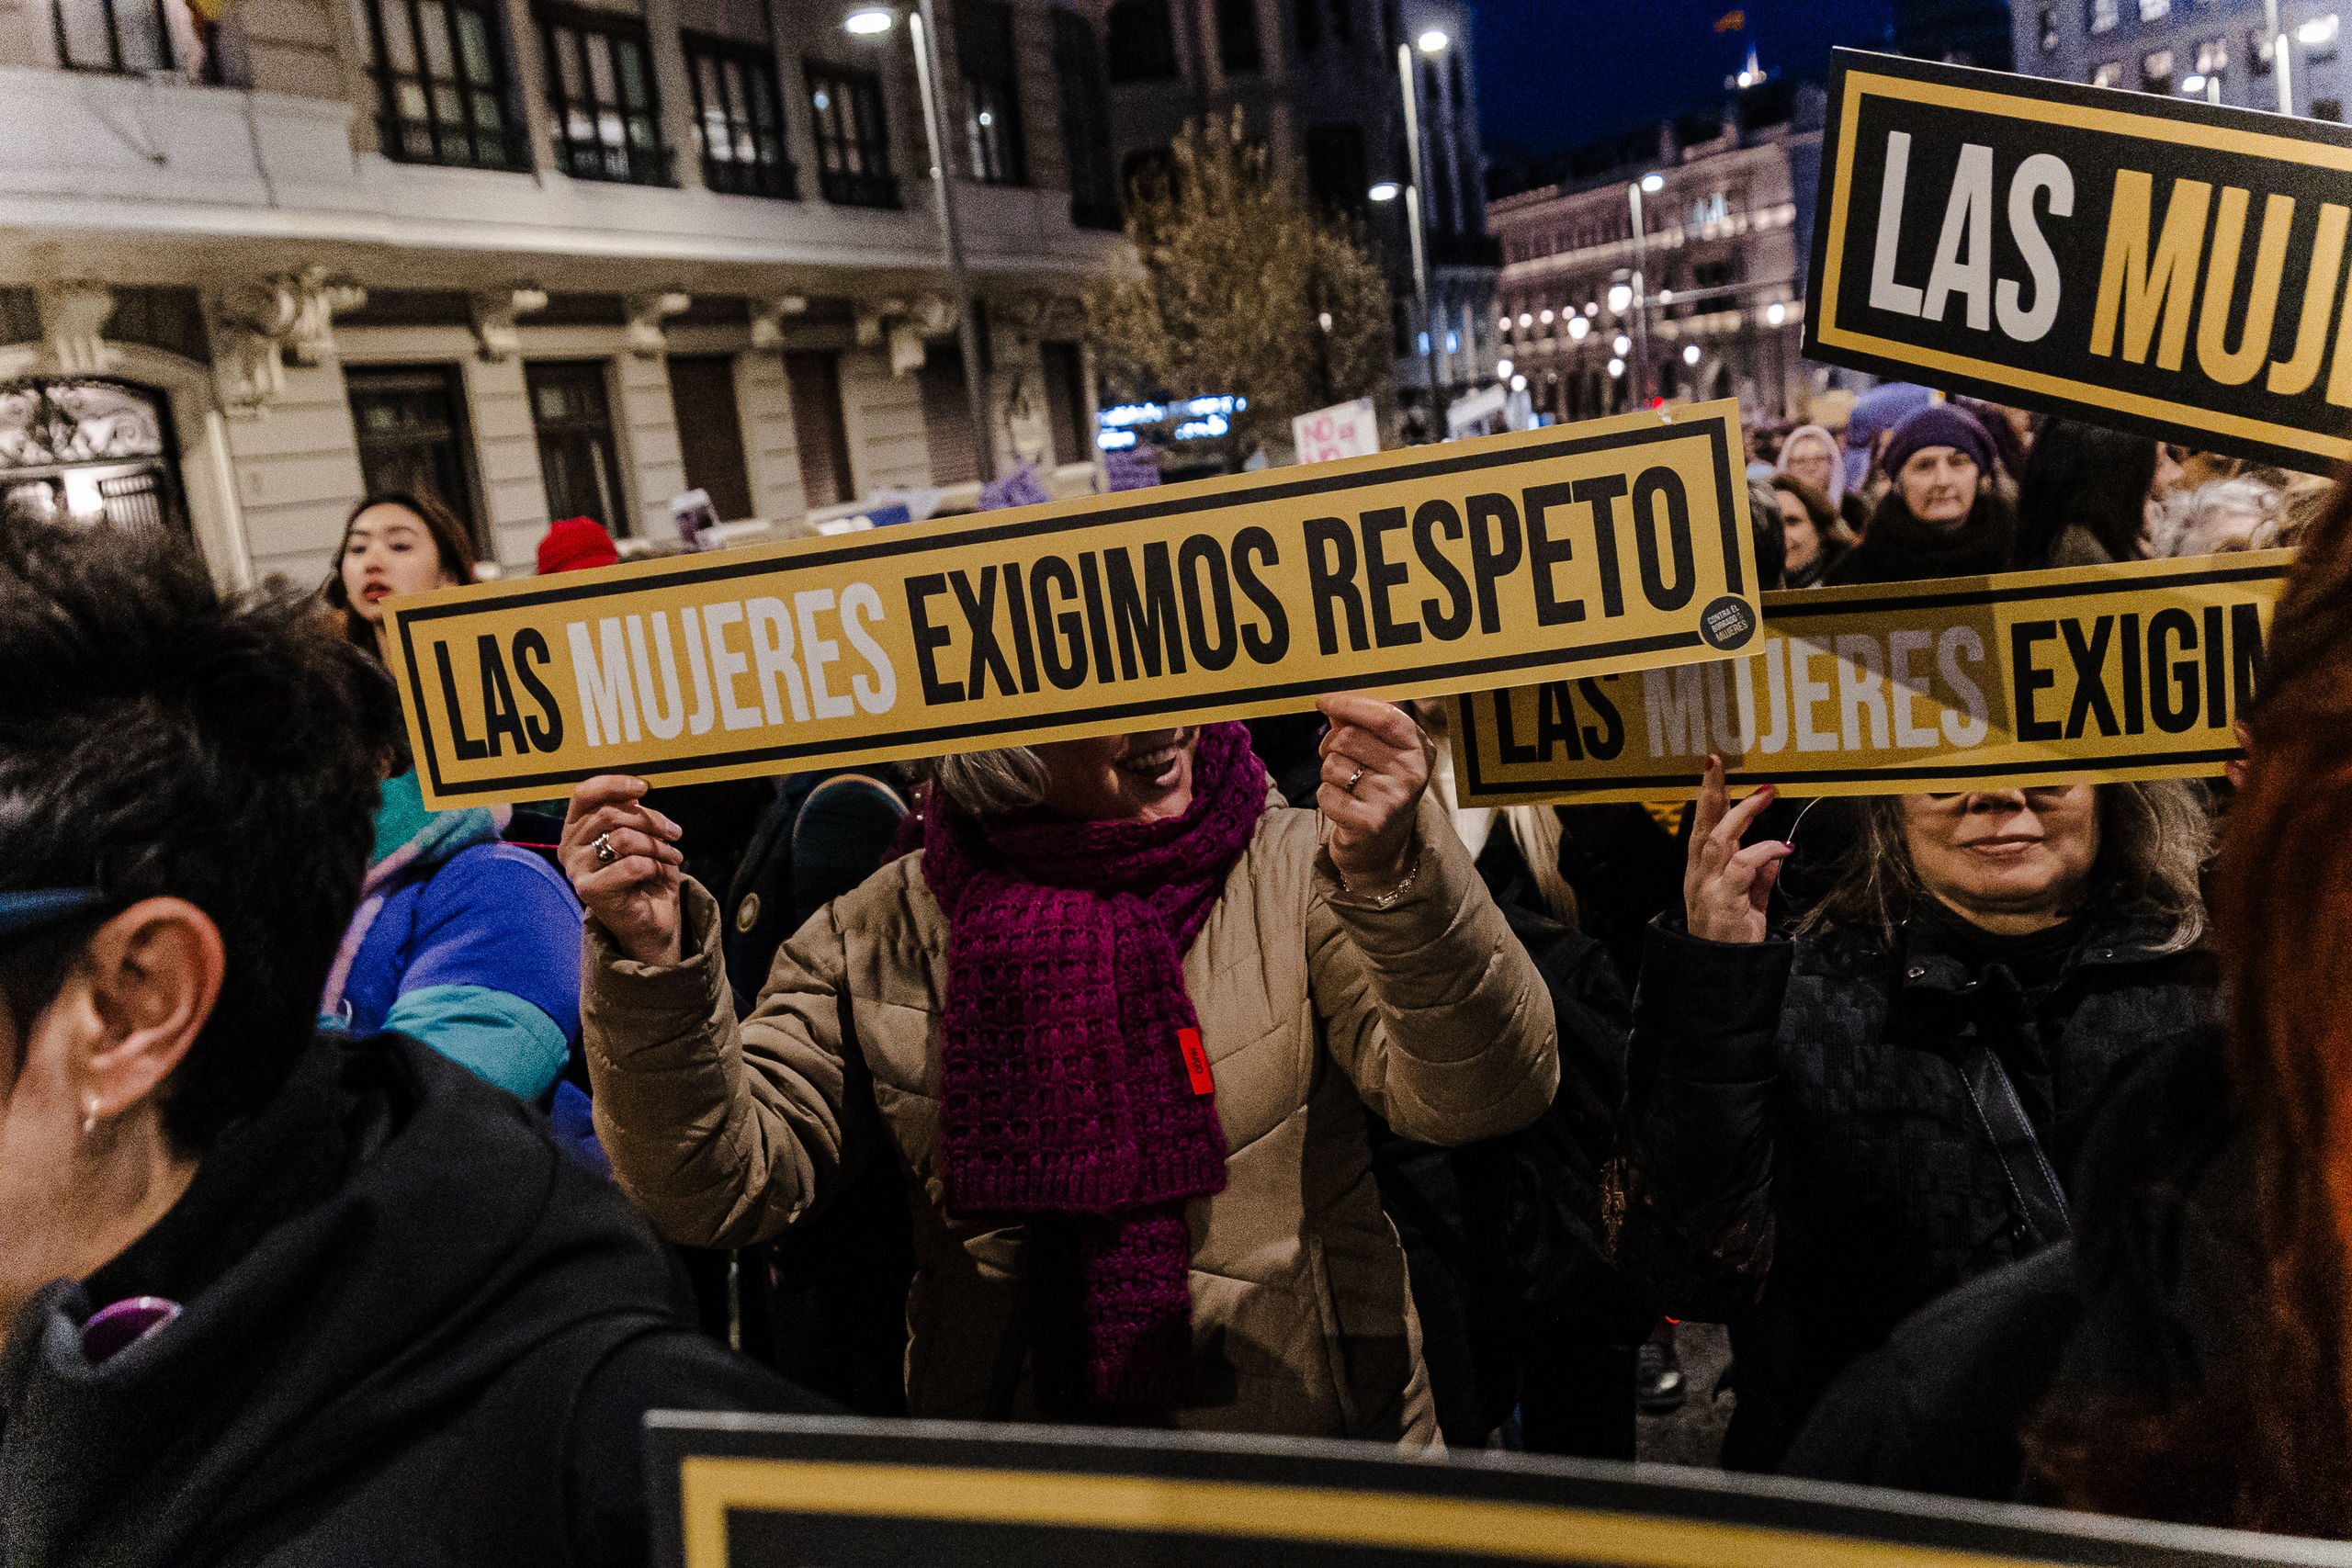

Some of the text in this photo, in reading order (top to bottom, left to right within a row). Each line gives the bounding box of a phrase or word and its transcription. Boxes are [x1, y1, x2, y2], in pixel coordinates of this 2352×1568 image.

[1869, 130, 2075, 343] LAS
[433, 466, 1697, 761] LAS MUJERES EXIGIMOS RESPETO
[1707, 608, 1731, 625] CONTRA
[1730, 604, 1740, 613] EL
[1715, 619, 1748, 642] MUJERES
[1493, 672, 1625, 764] LAS
[1642, 626, 1989, 758] MUJERES
